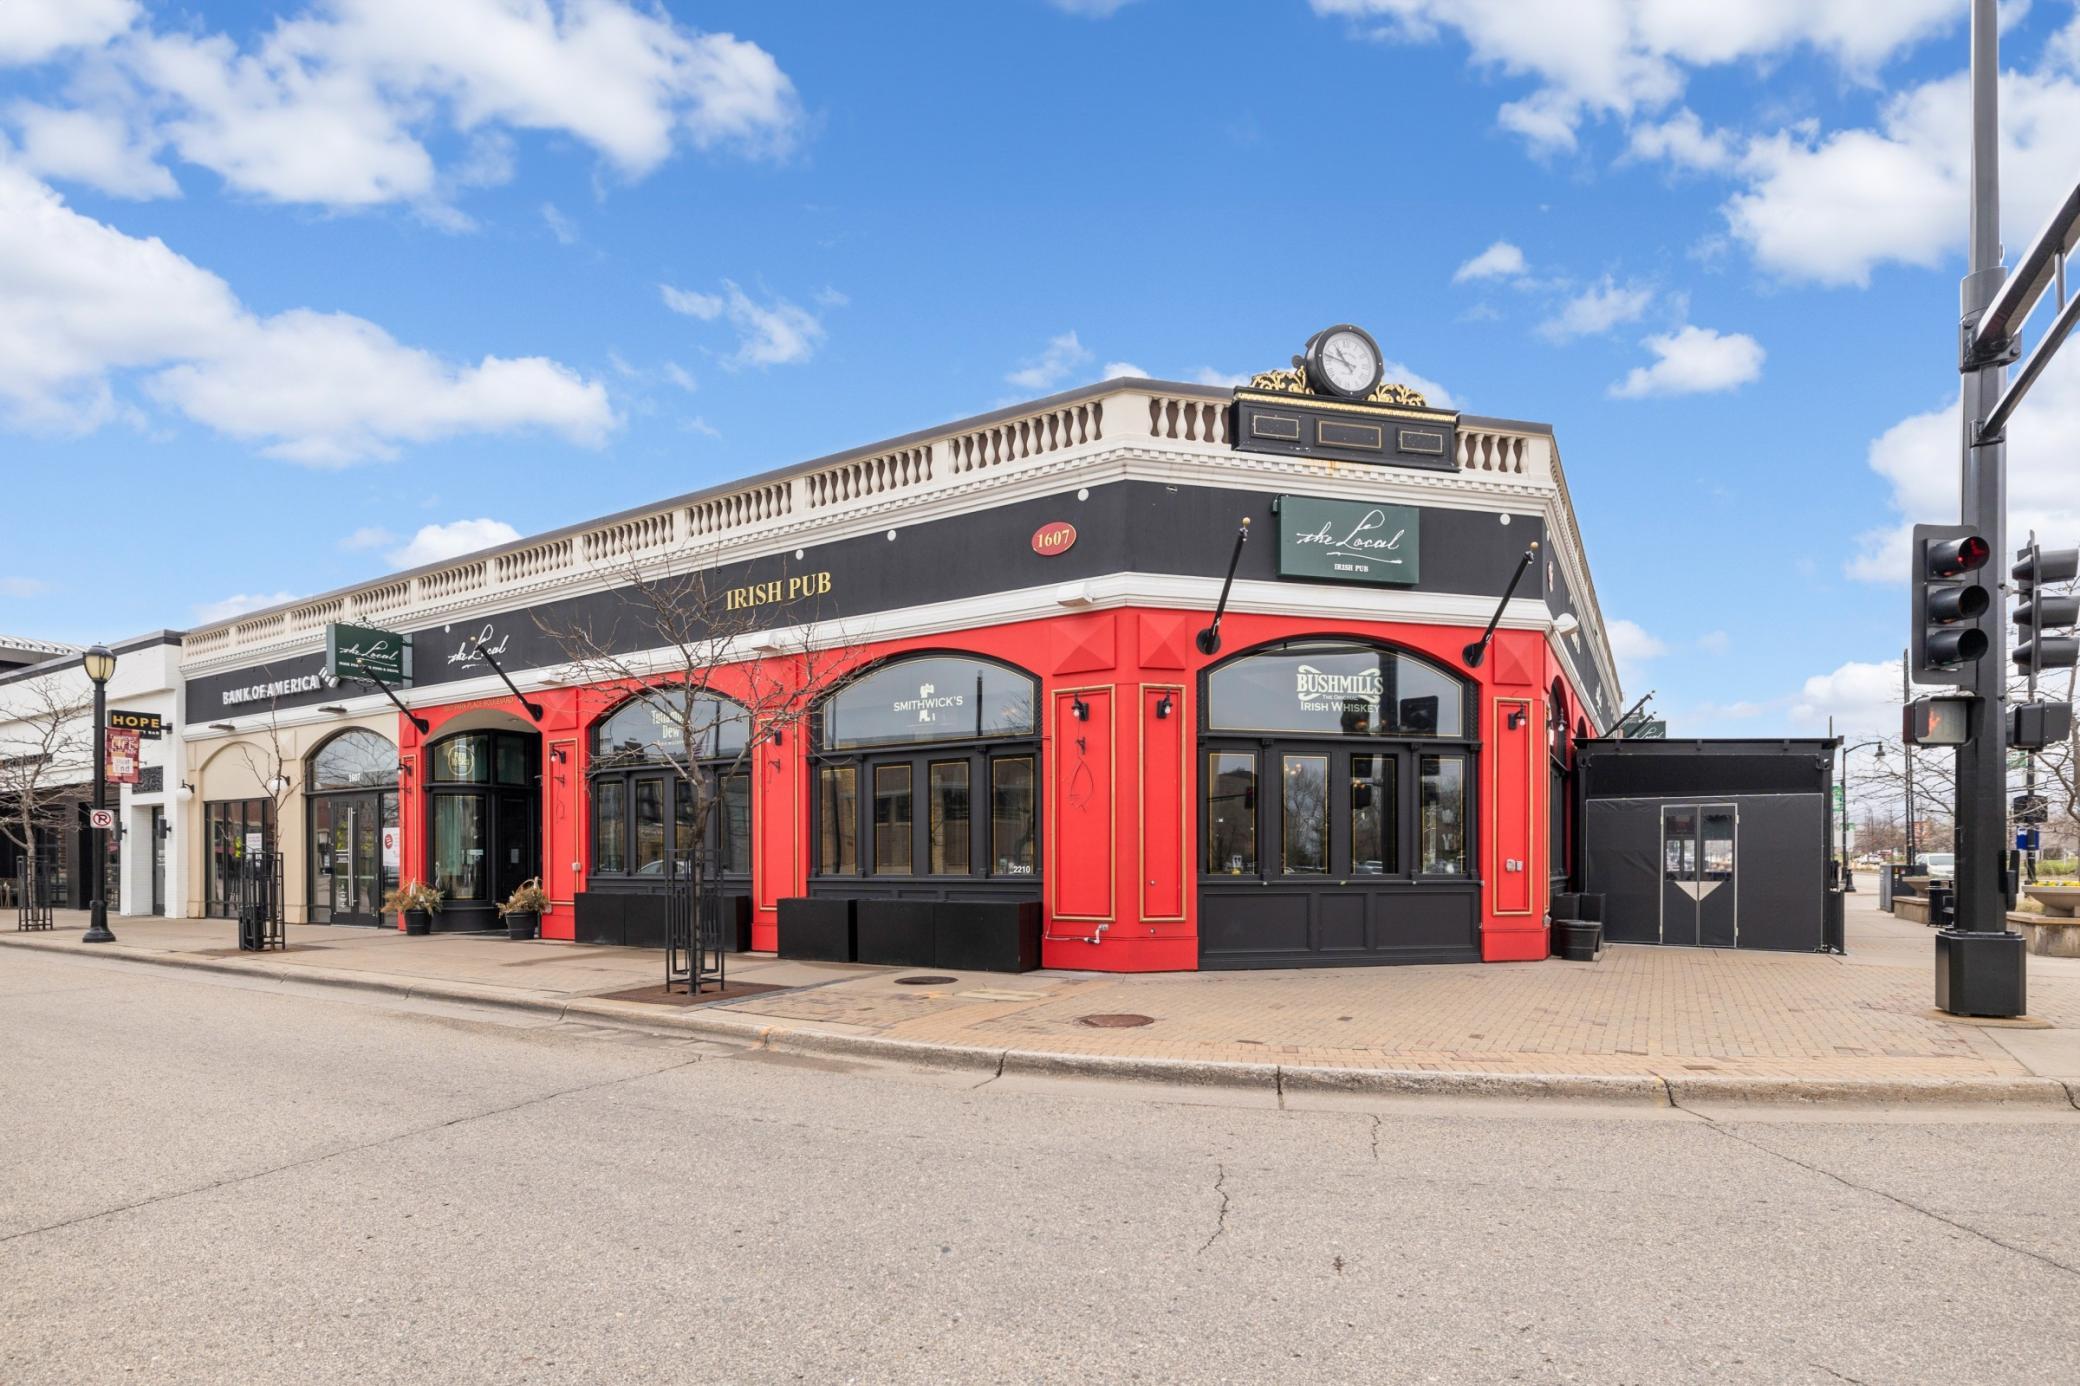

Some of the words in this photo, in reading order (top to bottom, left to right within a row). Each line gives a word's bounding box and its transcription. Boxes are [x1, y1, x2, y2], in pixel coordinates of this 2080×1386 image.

[1038, 529, 1070, 548] 1607
[1336, 509, 1404, 550] Local
[1334, 563, 1353, 572] IRISH
[1355, 565, 1369, 573] PUB
[726, 580, 783, 611] IRISH
[788, 571, 832, 600] PUB
[222, 687, 251, 705] BANK
[251, 684, 266, 699] OF
[266, 674, 321, 697] AMERICA
[1296, 673, 1384, 695] BUSHMILLS
[893, 695, 964, 712] SMITHWICK'S
[1300, 700, 1330, 712] IRISH
[1331, 701, 1381, 713] WHISKEY
[112, 715, 160, 728] HOPE
[1013, 865, 1031, 874] 2210
